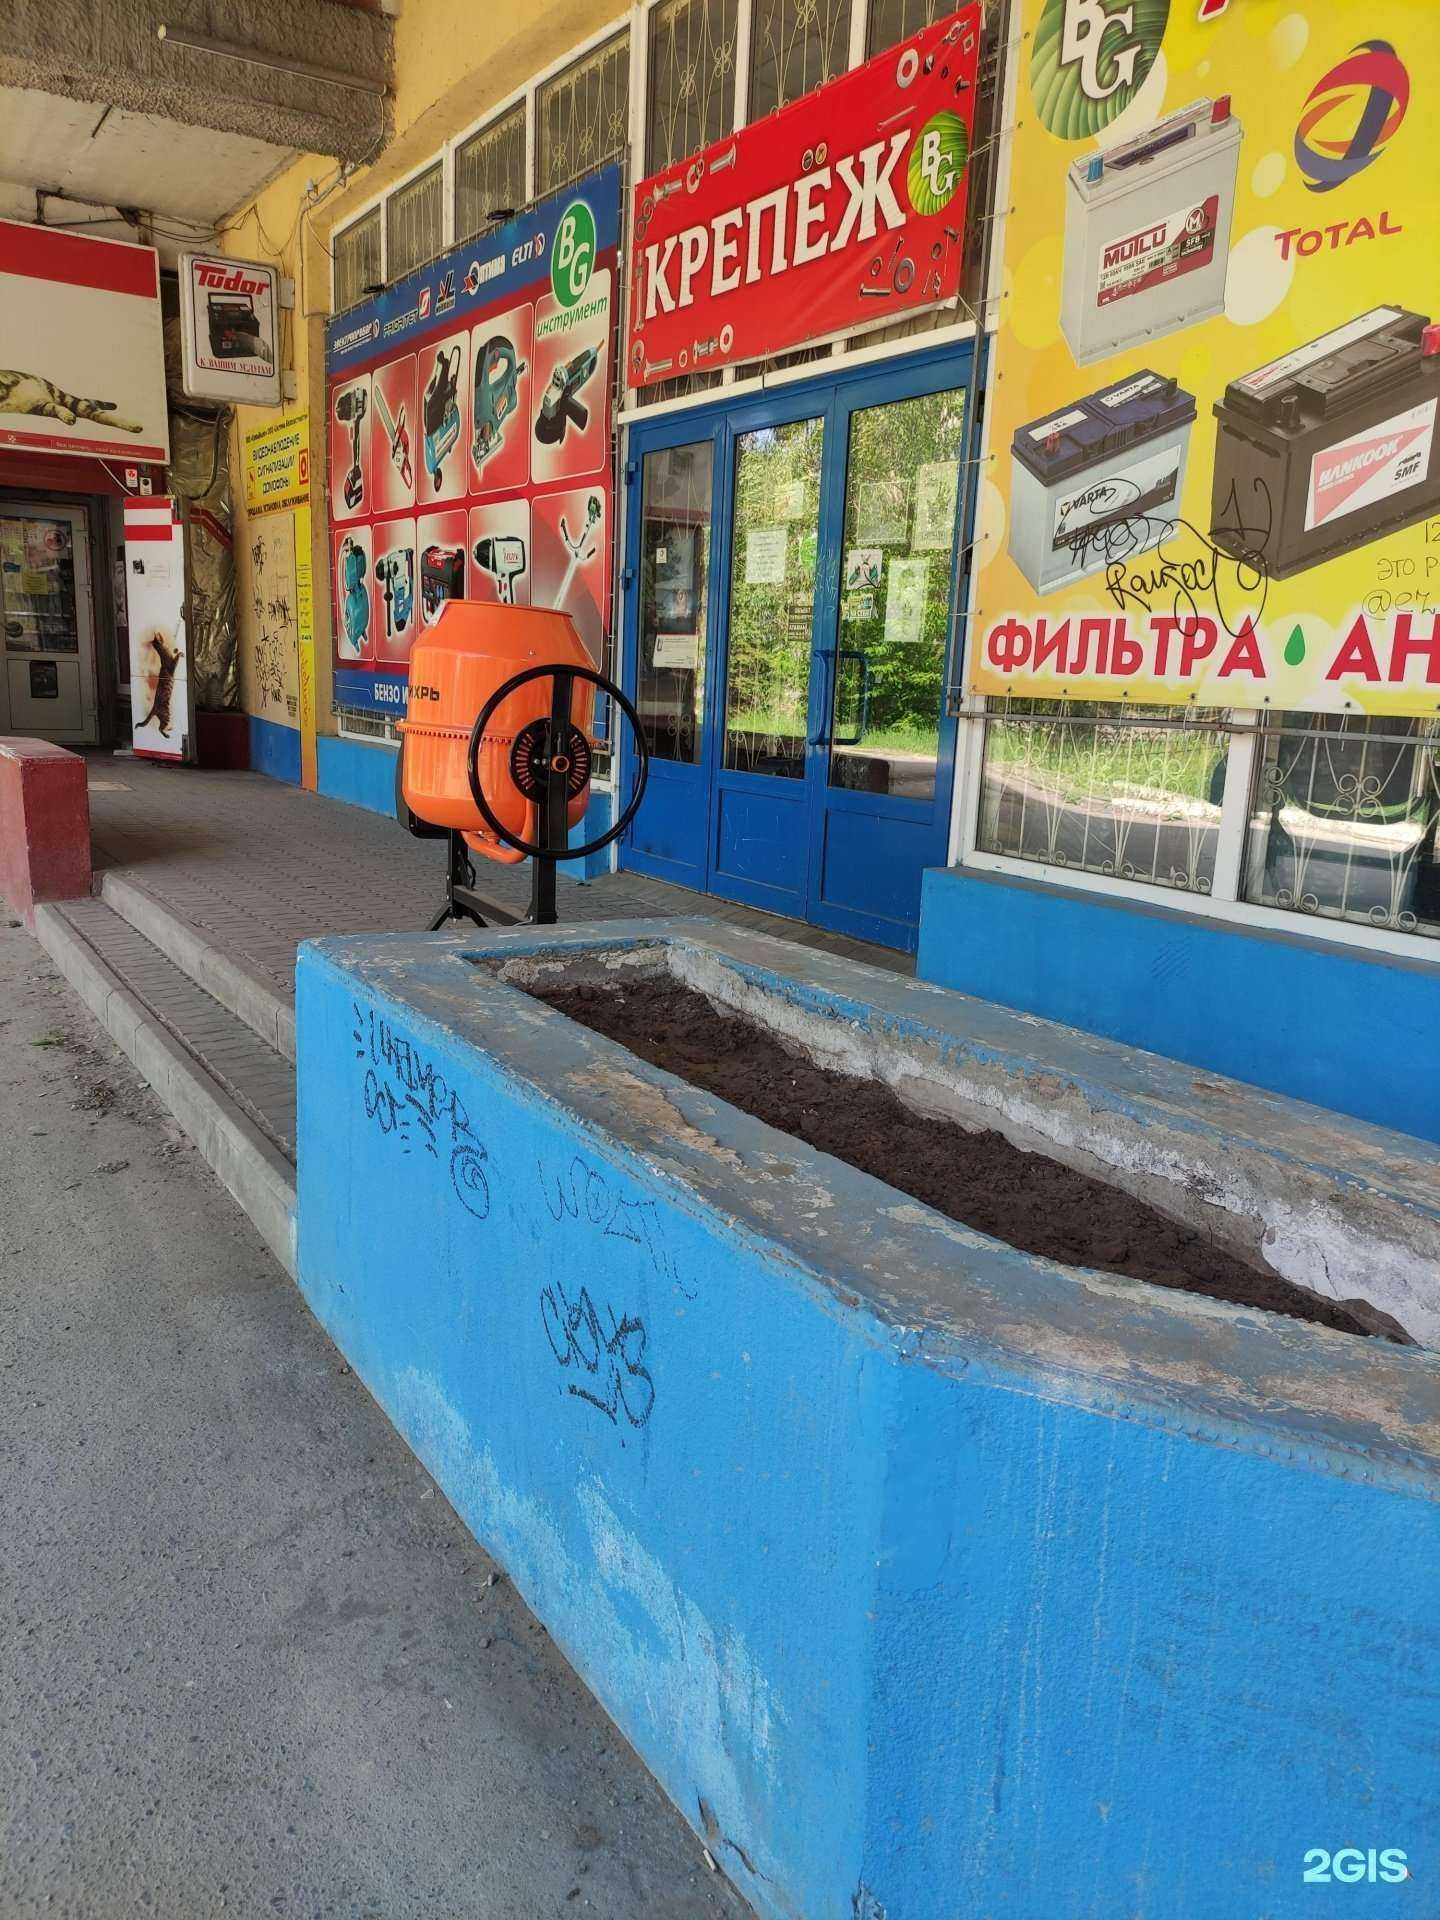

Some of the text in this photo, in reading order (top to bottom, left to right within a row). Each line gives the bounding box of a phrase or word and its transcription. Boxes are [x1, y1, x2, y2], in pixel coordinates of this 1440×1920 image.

[921, 130, 958, 196] BG
[558, 215, 590, 297] BG
[1103, 222, 1167, 269] MUTLU
[1274, 211, 1402, 262] TOTAL
[537, 297, 607, 336] инструмент
[1318, 435, 1404, 487] HANKOOK
[1394, 461, 1420, 481] SMF
[1425, 556, 1440, 577] Р
[987, 613, 1440, 684] ФИЛЬТРА АН
[374, 683, 400, 704] БЕНЗО
[408, 685, 440, 701] ИХРЬ
